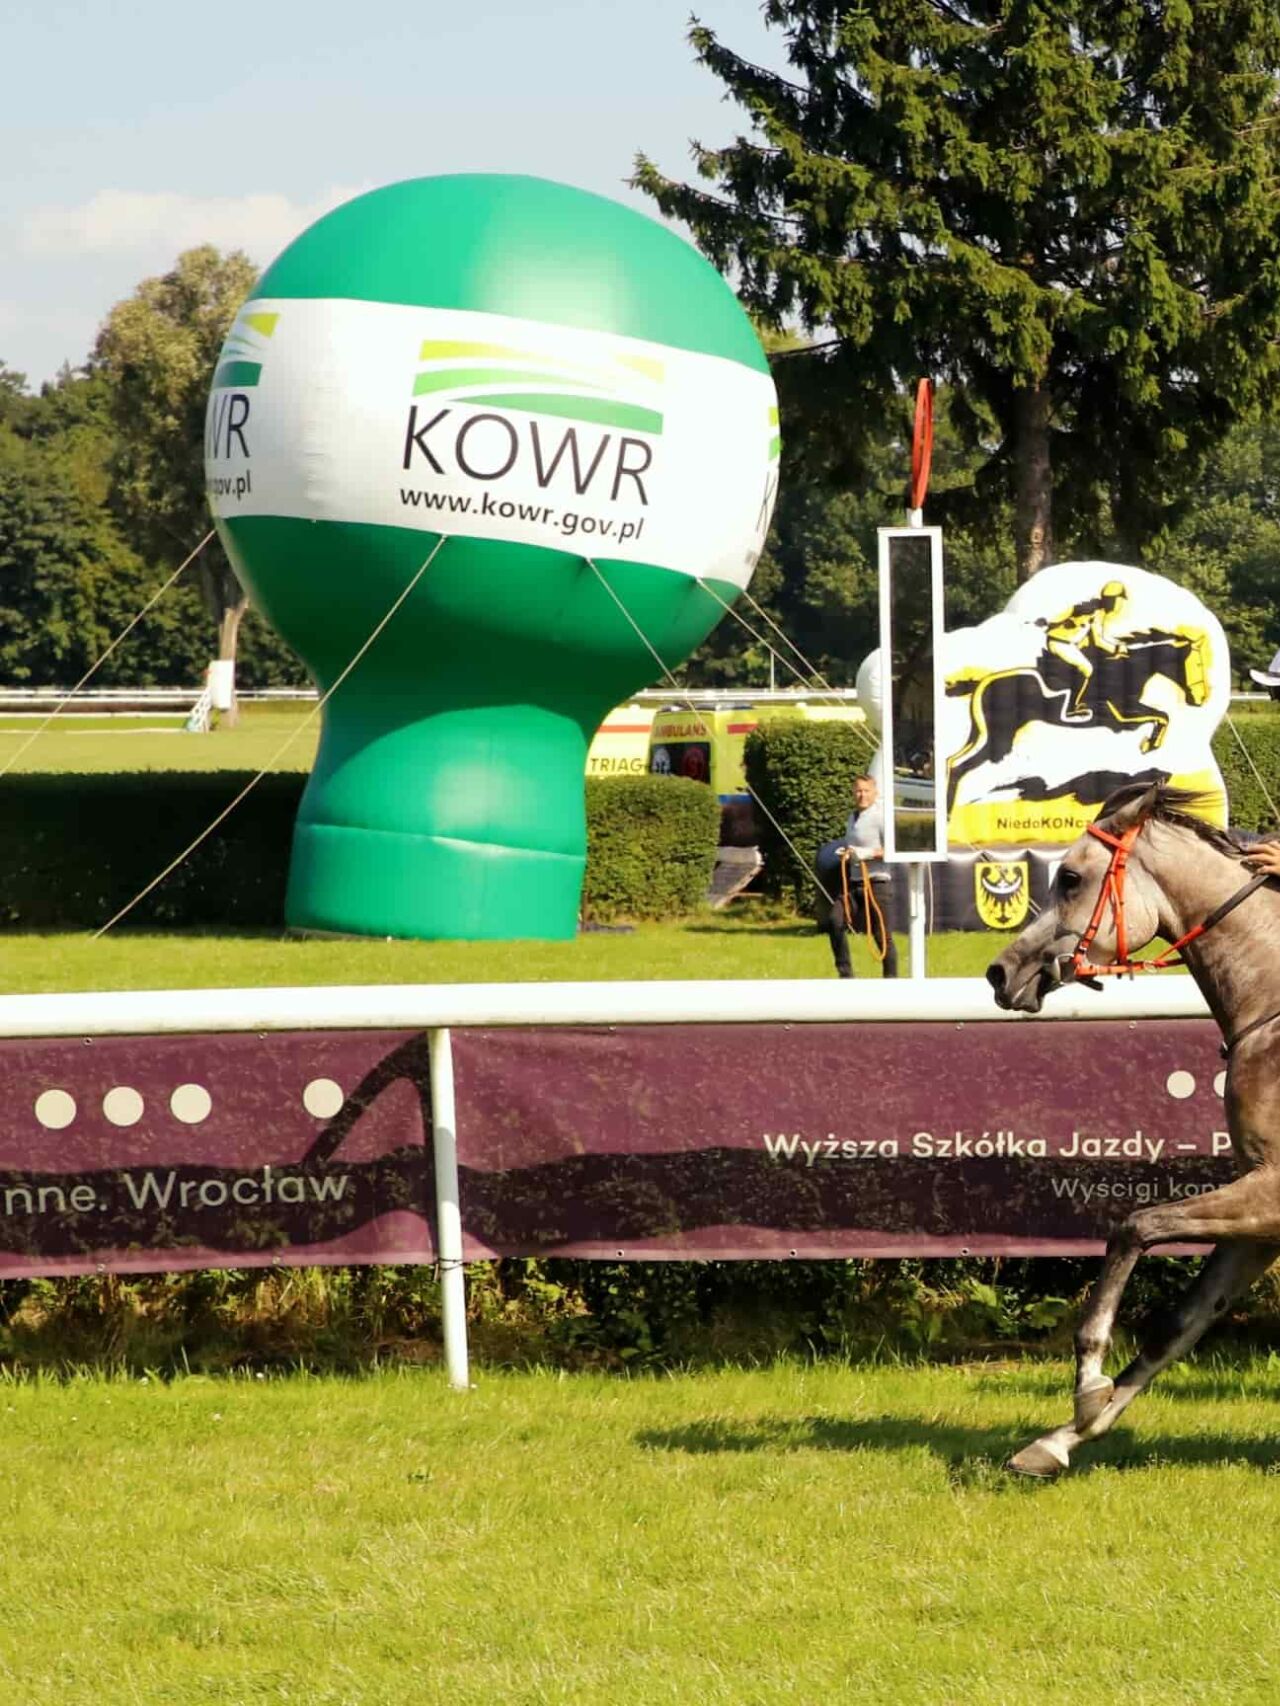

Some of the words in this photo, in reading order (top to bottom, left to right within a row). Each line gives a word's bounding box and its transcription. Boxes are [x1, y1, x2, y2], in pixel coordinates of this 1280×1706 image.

[402, 404, 653, 506] KOWR
[400, 487, 645, 544] www.kowr.gov.pl
[763, 1132, 899, 1167] Wyższa
[912, 1131, 1047, 1159] Szkółka
[1059, 1130, 1165, 1165] Jazdy
[123, 1164, 348, 1210] Wrocław
[1050, 1177, 1159, 1204] Wyścigi
